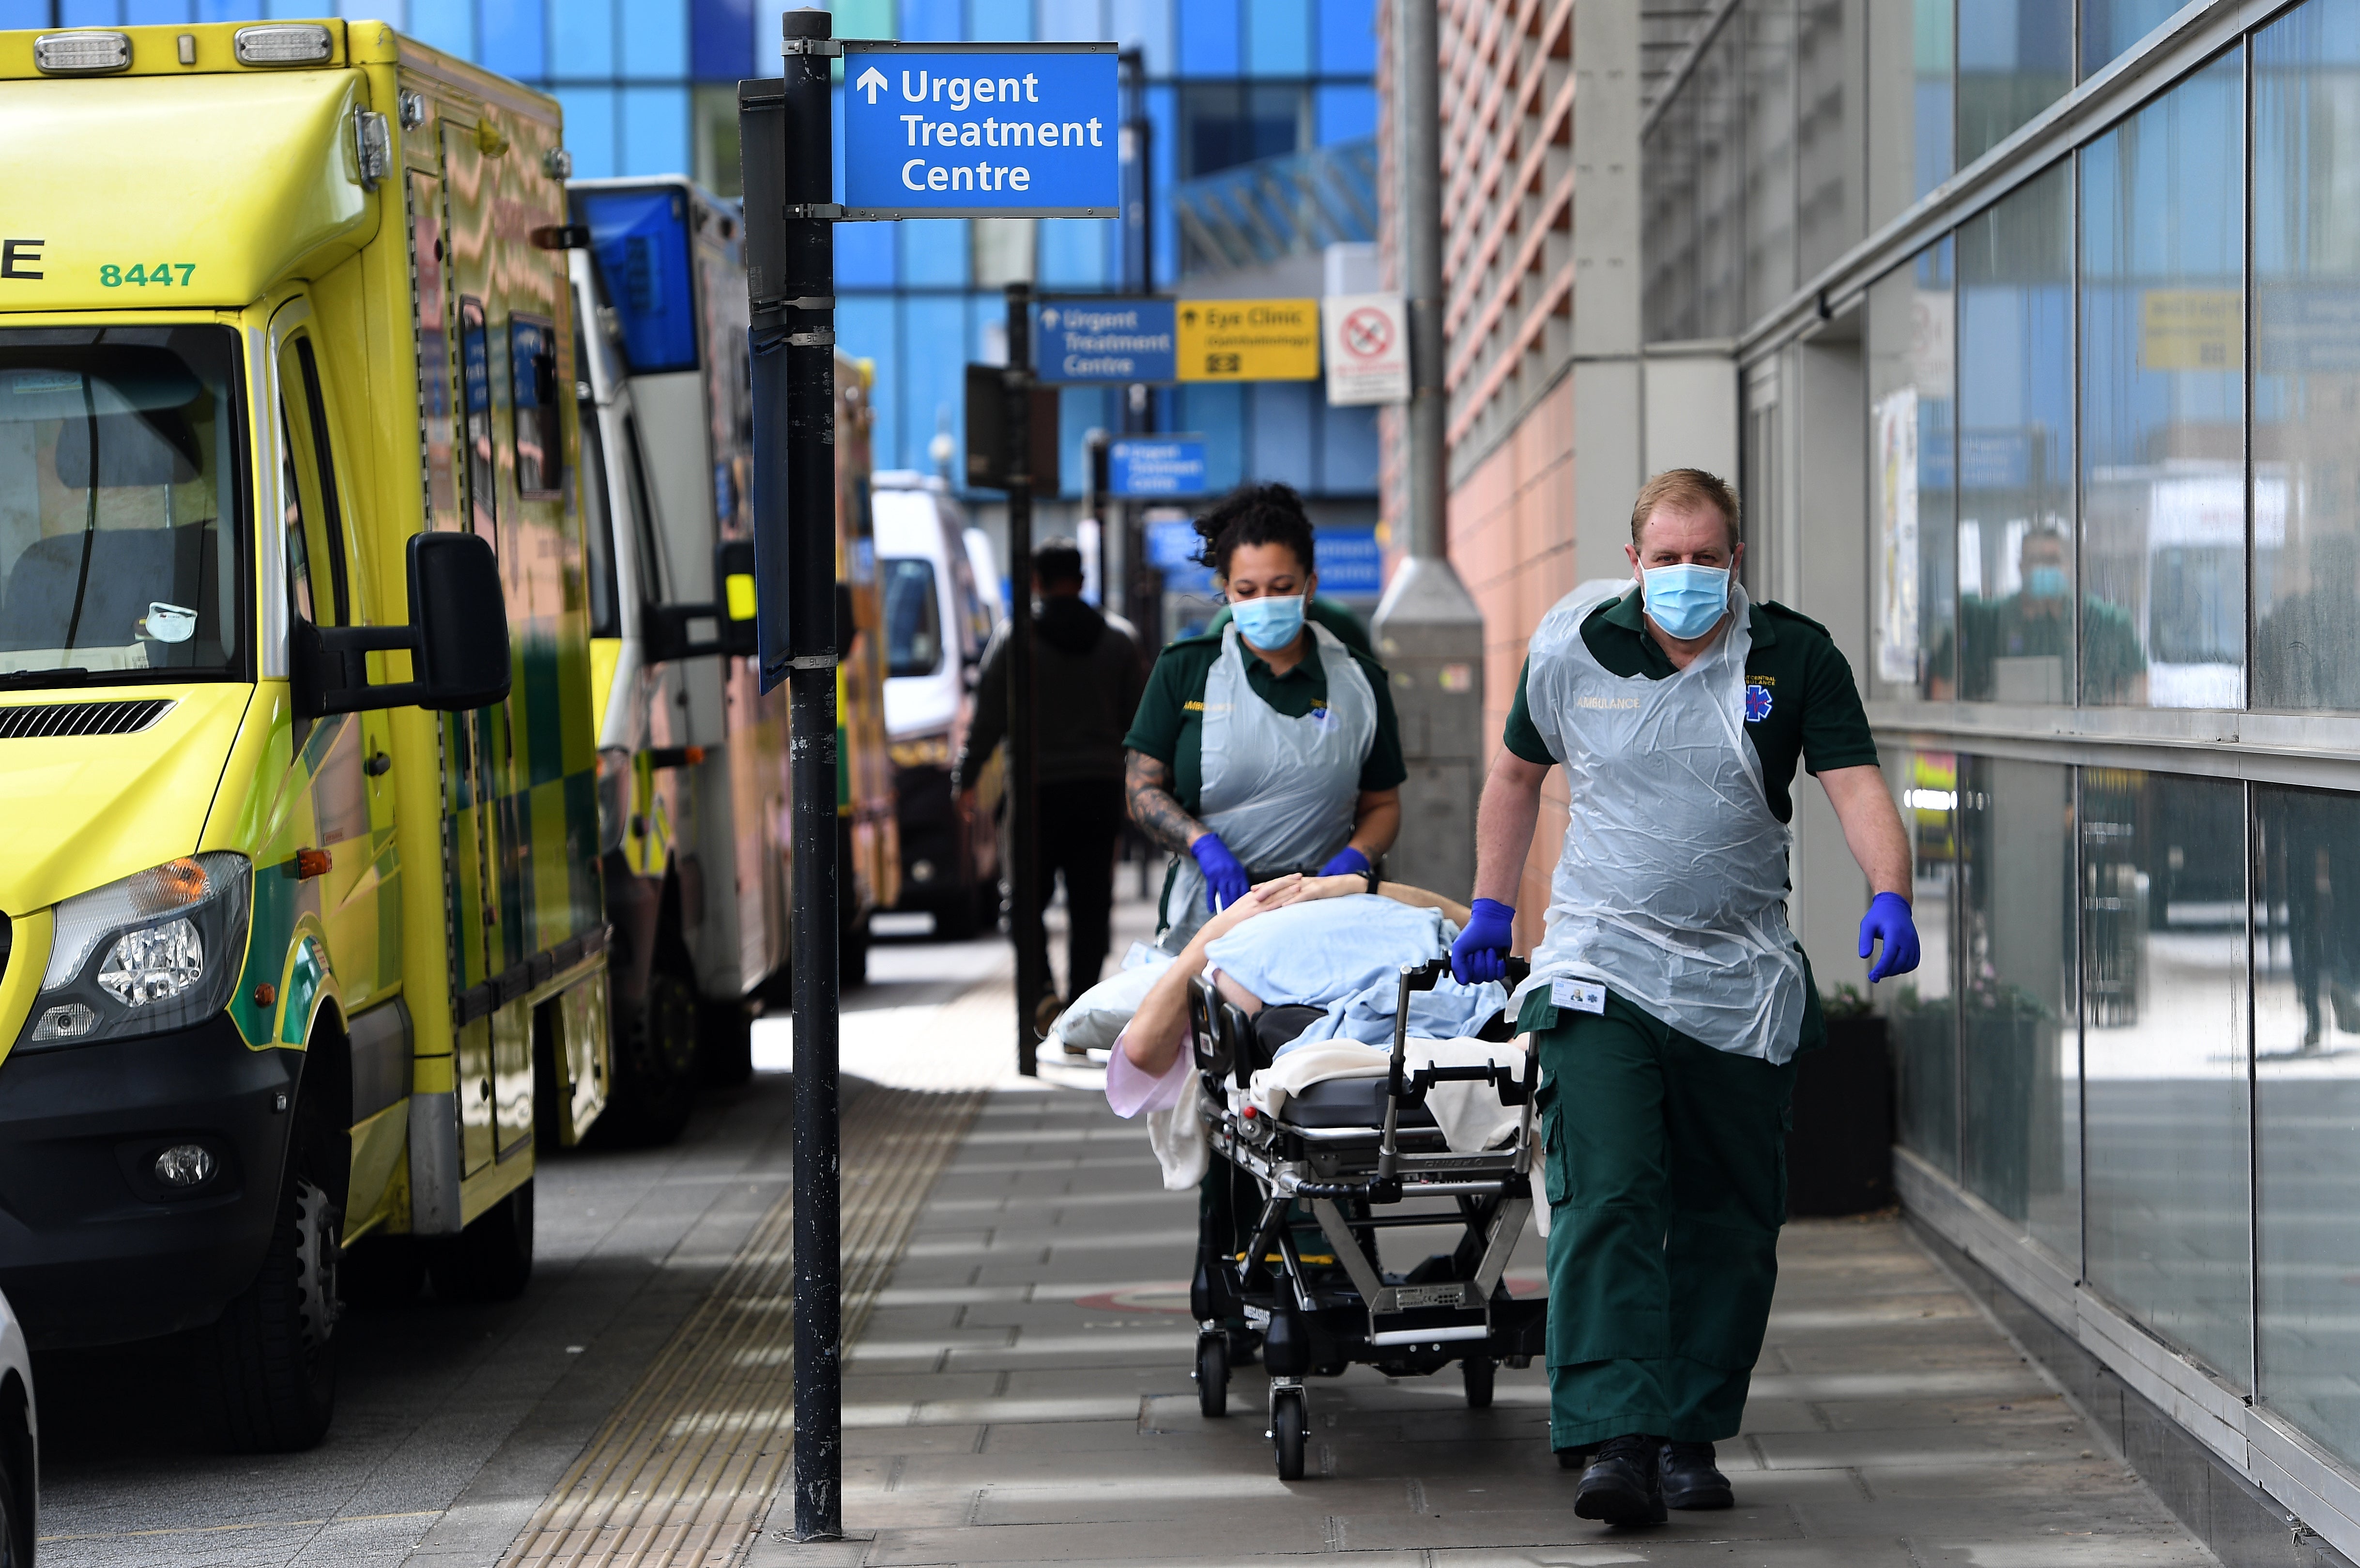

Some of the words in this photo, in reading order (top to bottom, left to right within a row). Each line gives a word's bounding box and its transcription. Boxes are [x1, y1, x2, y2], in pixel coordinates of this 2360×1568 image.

[902, 71, 1038, 111] Urgent
[900, 115, 1103, 147] Treatment
[902, 159, 1030, 190] Centre
[100, 263, 196, 287] 8447
[1064, 310, 1137, 333] Urgent
[1206, 309, 1241, 328] Eye
[1247, 308, 1303, 326] Clinic
[1065, 332, 1170, 352] Treatment
[1064, 354, 1134, 375] Centre
[1578, 696, 1640, 709] AMBULANCE
